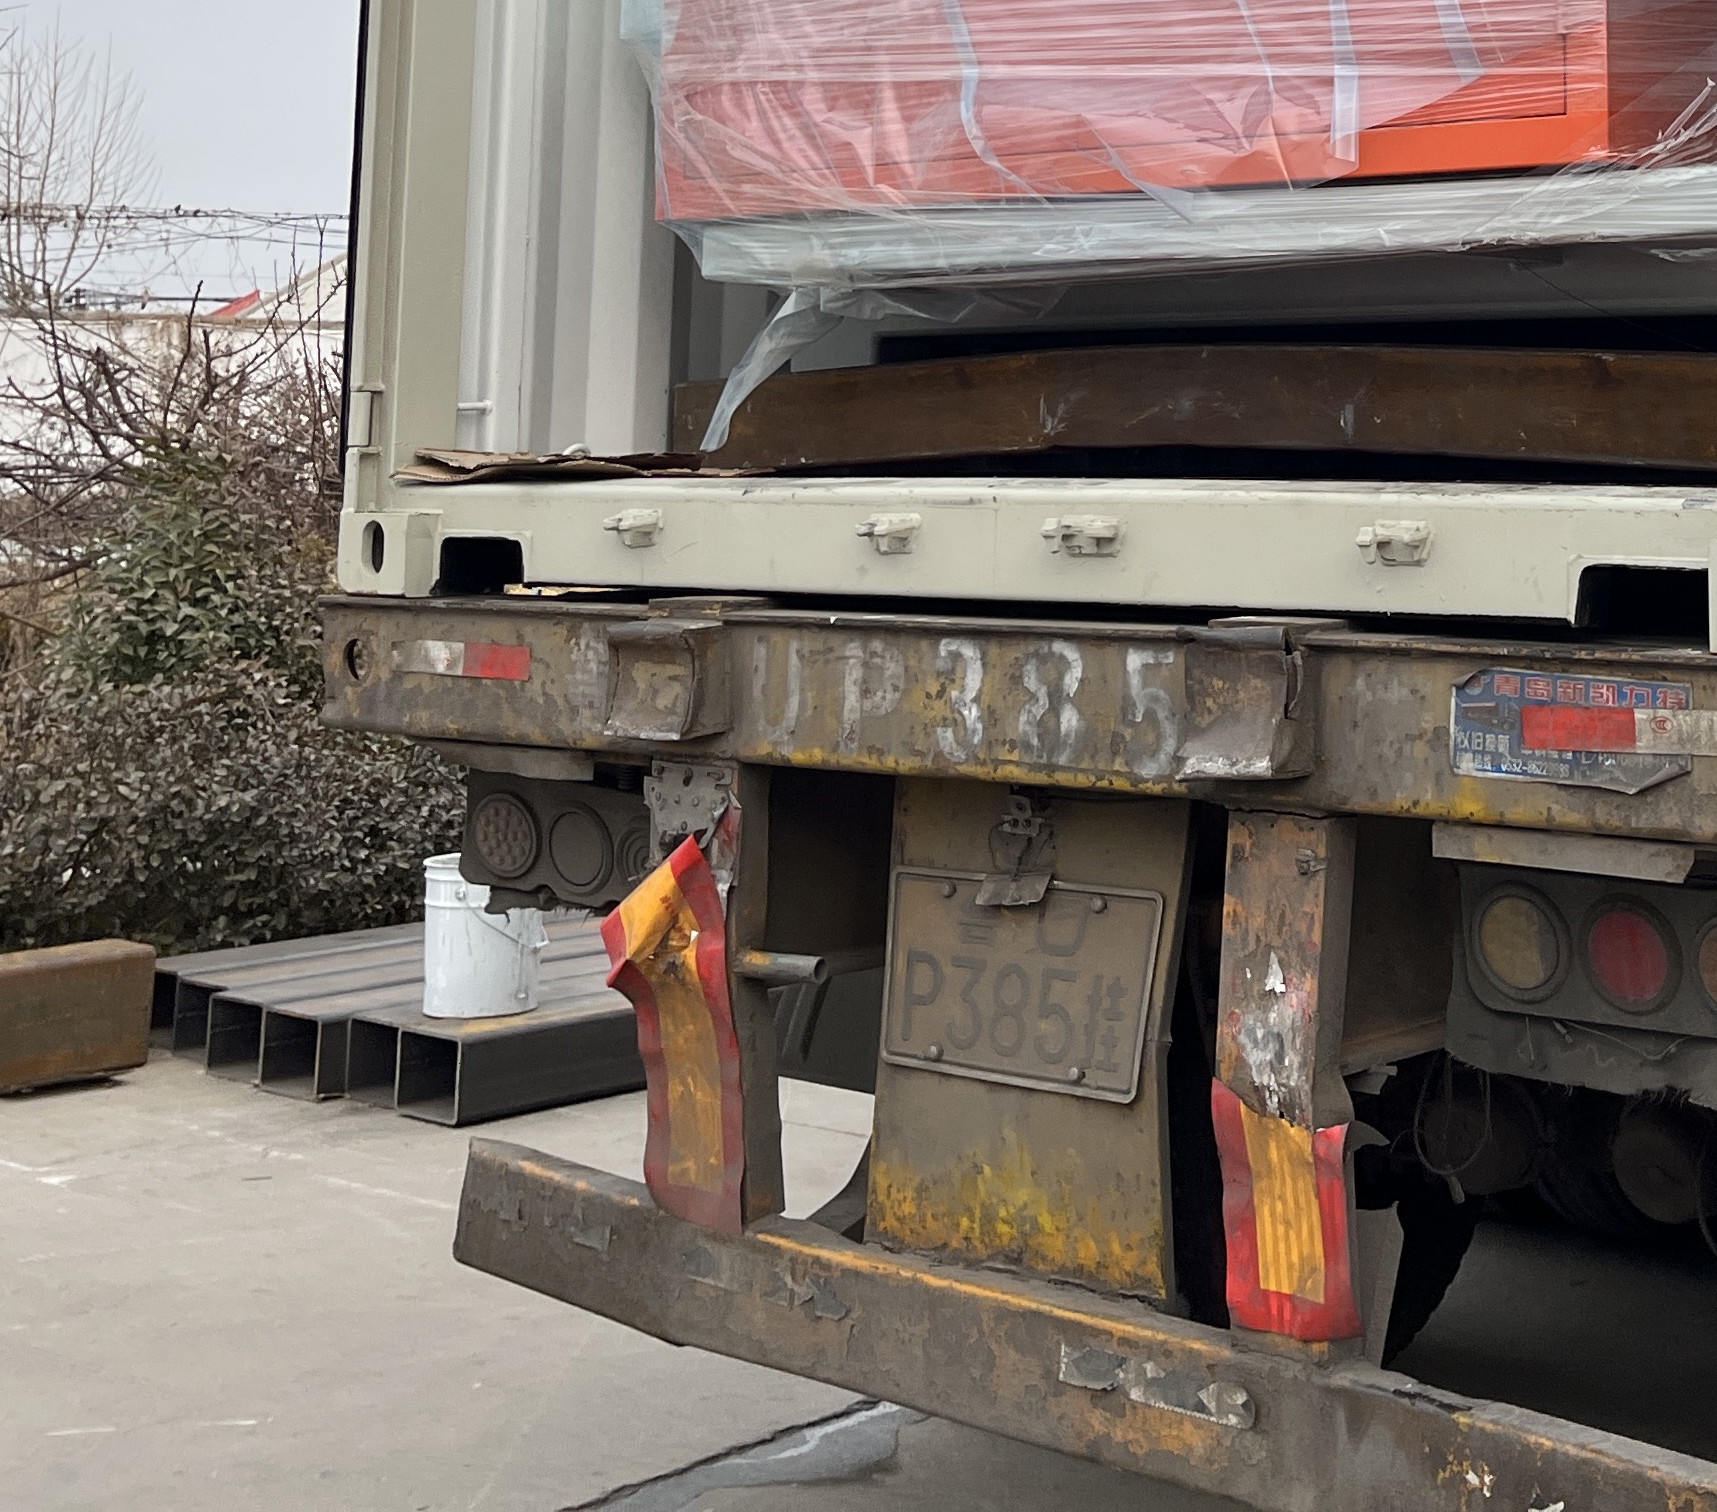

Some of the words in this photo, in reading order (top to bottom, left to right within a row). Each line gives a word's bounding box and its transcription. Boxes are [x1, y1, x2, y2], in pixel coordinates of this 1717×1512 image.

[1493, 674, 1686, 711] 青岛新凯力特
